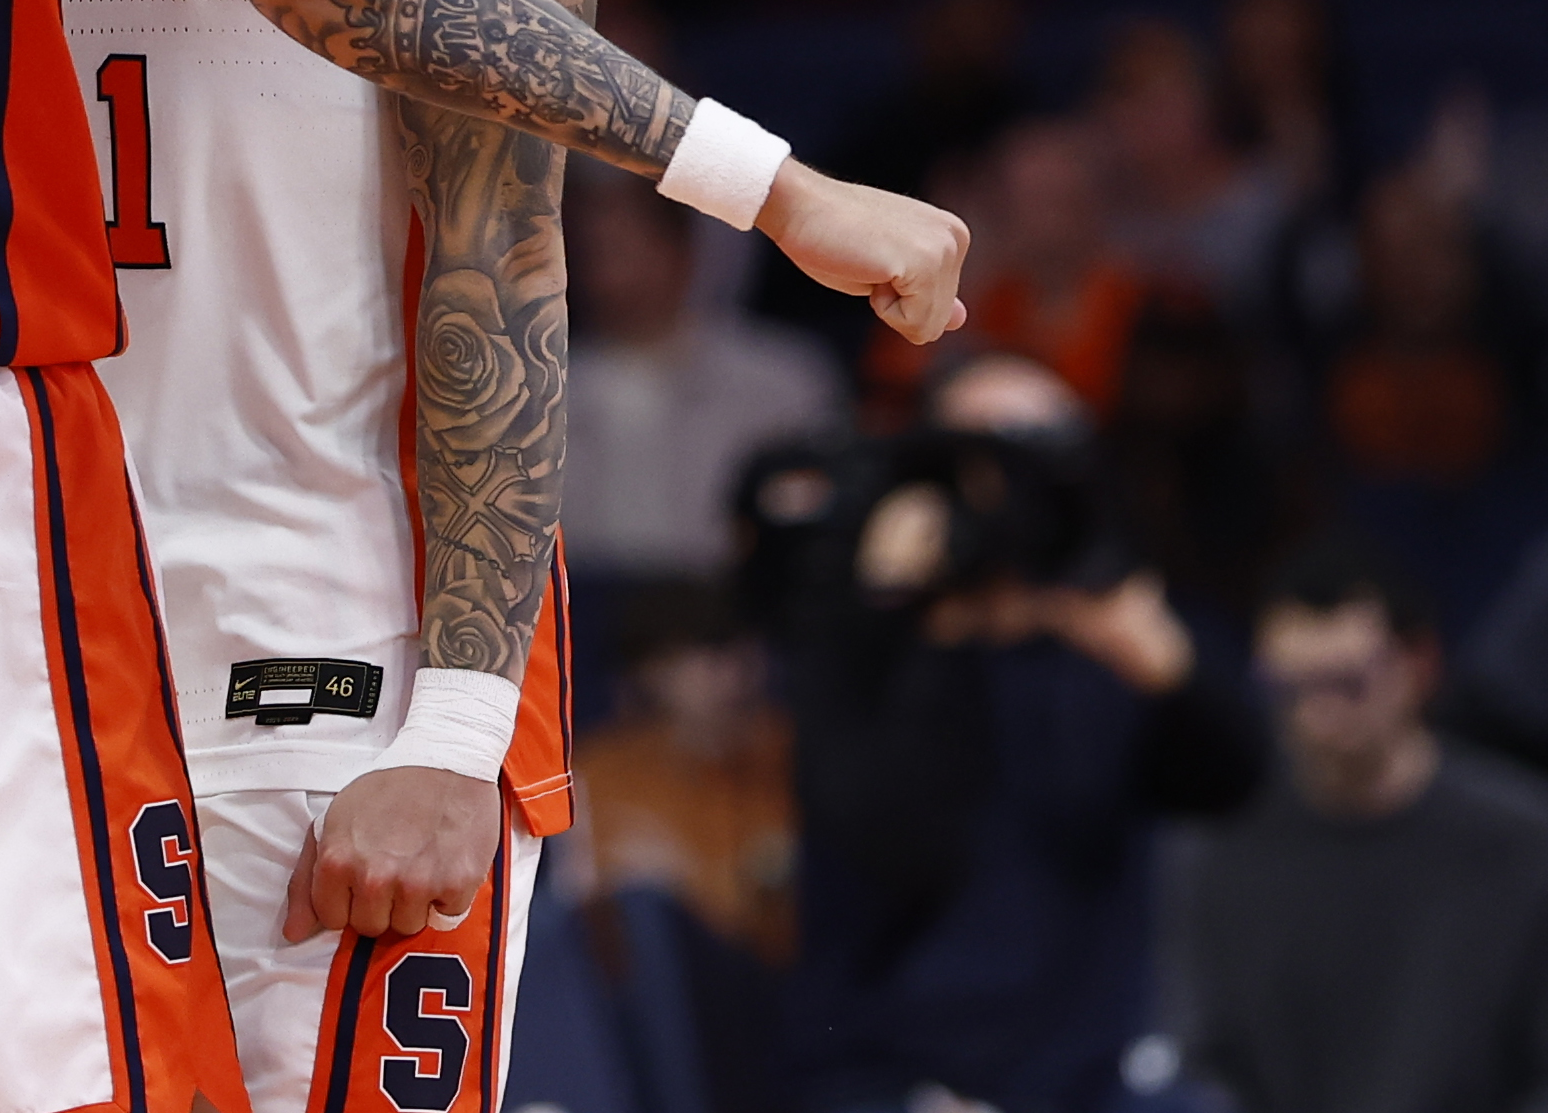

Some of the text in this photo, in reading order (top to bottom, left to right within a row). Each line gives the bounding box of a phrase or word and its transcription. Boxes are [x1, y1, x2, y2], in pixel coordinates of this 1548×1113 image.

[96, 53, 172, 269] 1
[325, 676, 354, 697] 46
[128, 798, 193, 965] S
[379, 951, 473, 1113] S
